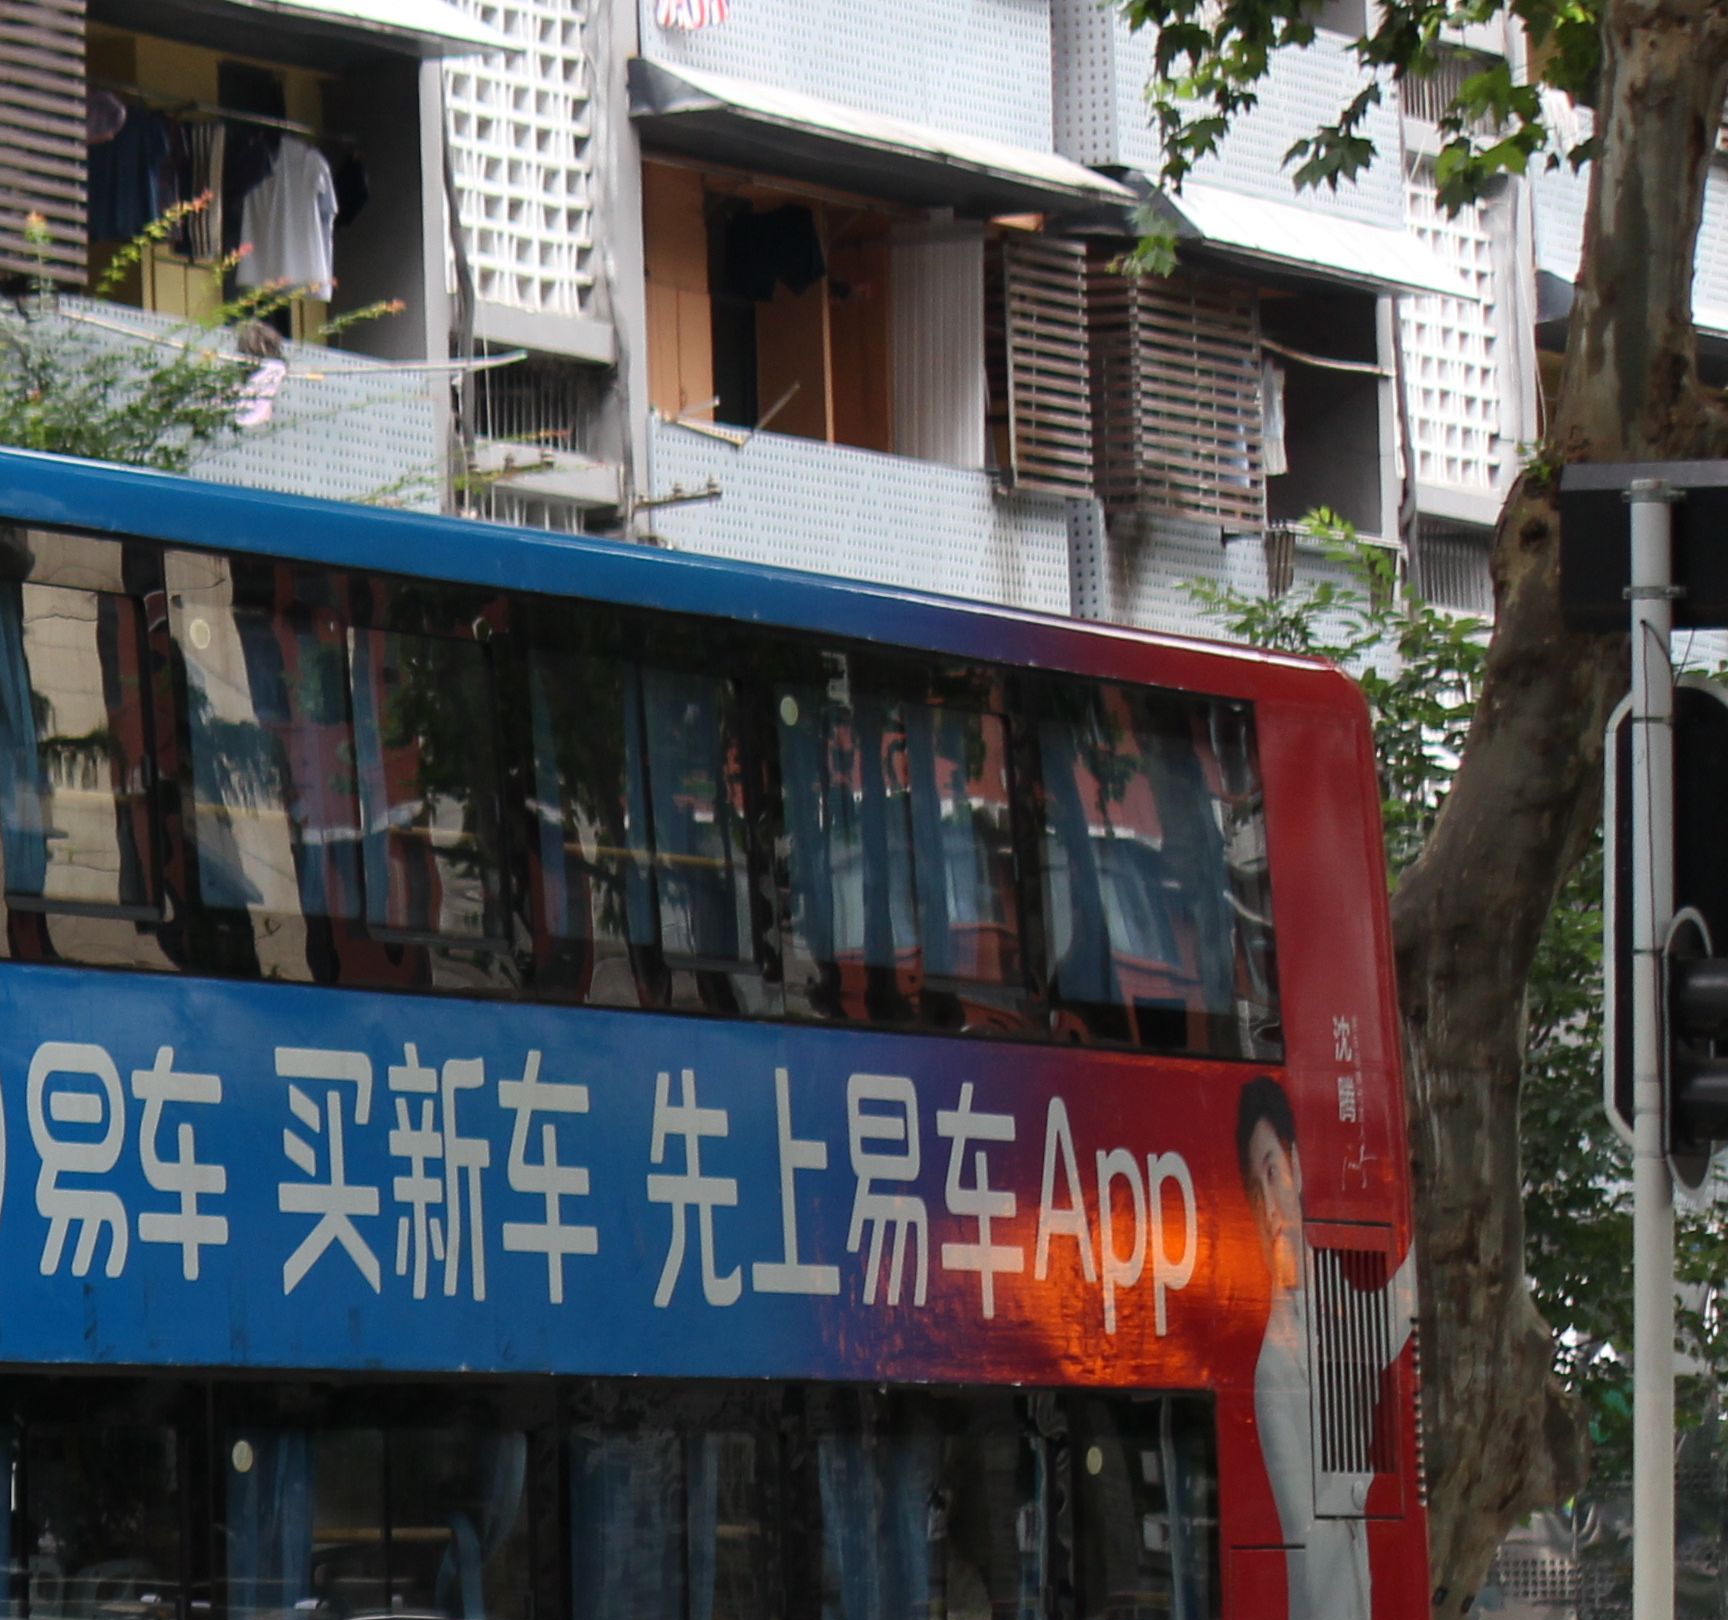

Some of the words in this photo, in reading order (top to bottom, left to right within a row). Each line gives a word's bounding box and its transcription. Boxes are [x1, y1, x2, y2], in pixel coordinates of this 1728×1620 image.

[26, 1040, 229, 1281] 易车
[274, 1041, 598, 1304] 买新车
[647, 1066, 1198, 1337] 先上易车App
